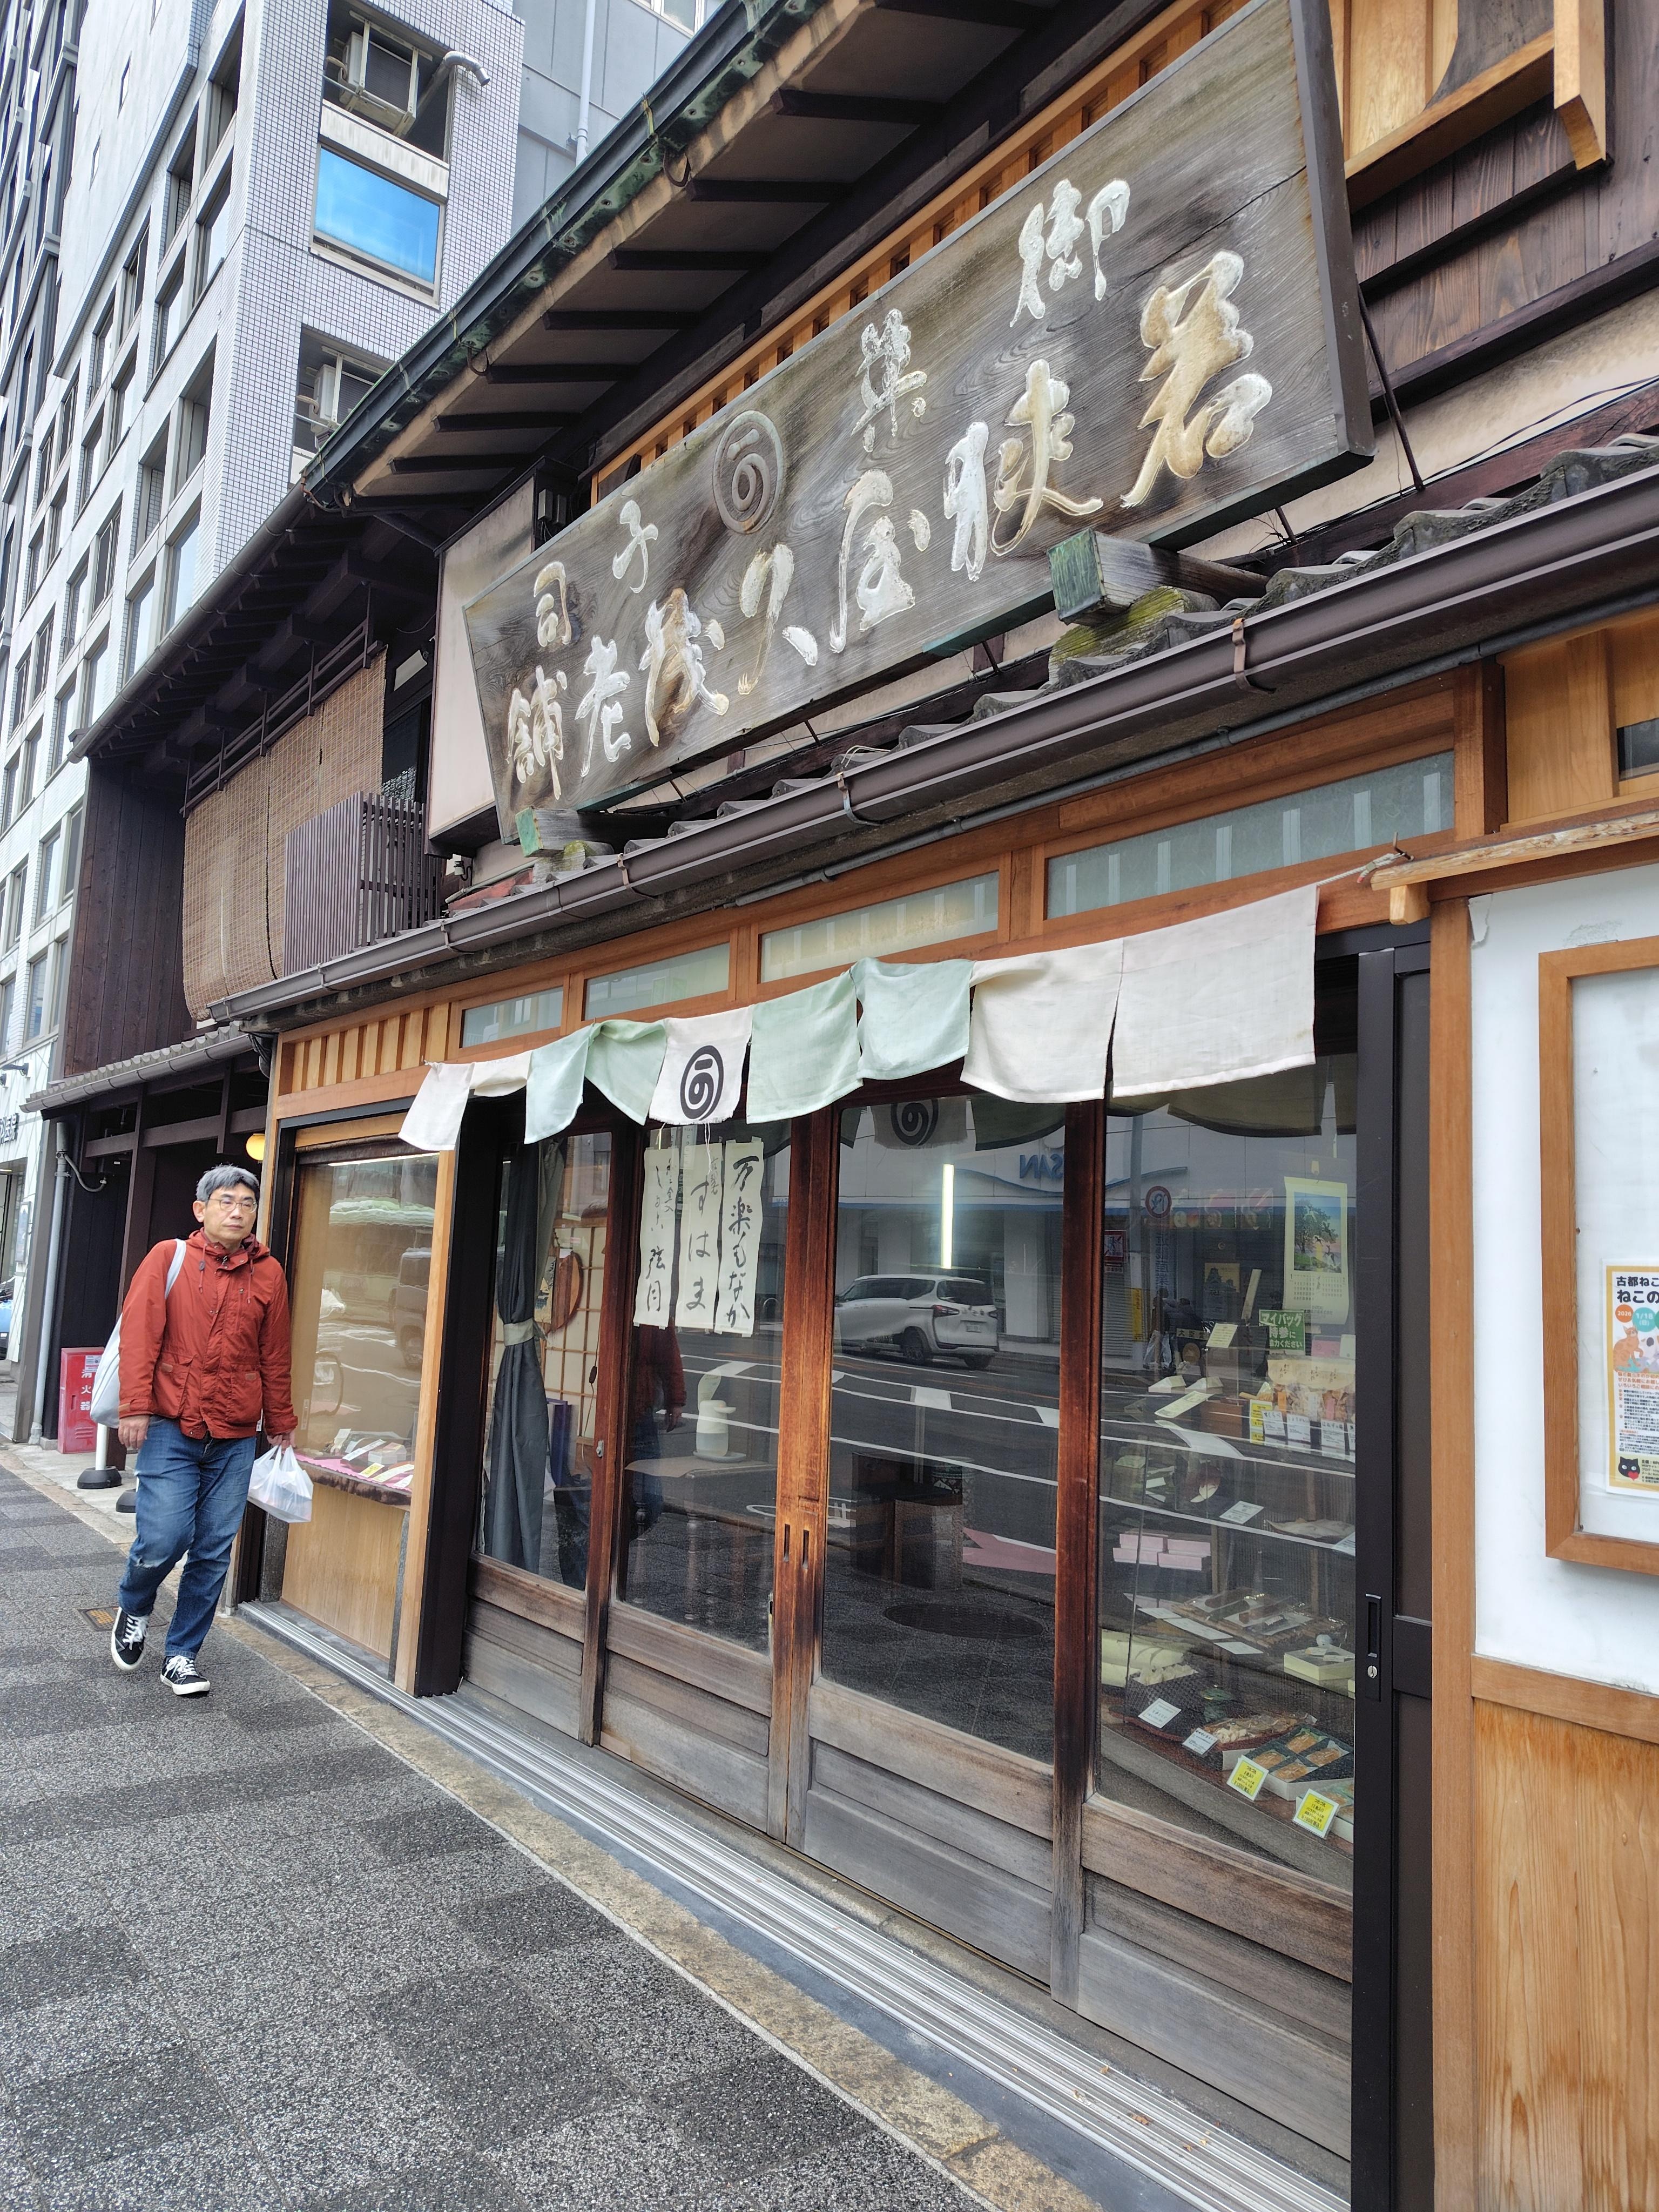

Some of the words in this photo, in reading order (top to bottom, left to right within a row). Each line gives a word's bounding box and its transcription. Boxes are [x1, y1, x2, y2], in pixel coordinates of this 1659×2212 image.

[1261, 1313, 1303, 1327] マイバッグ
[79, 1368, 92, 1411] 消火器
